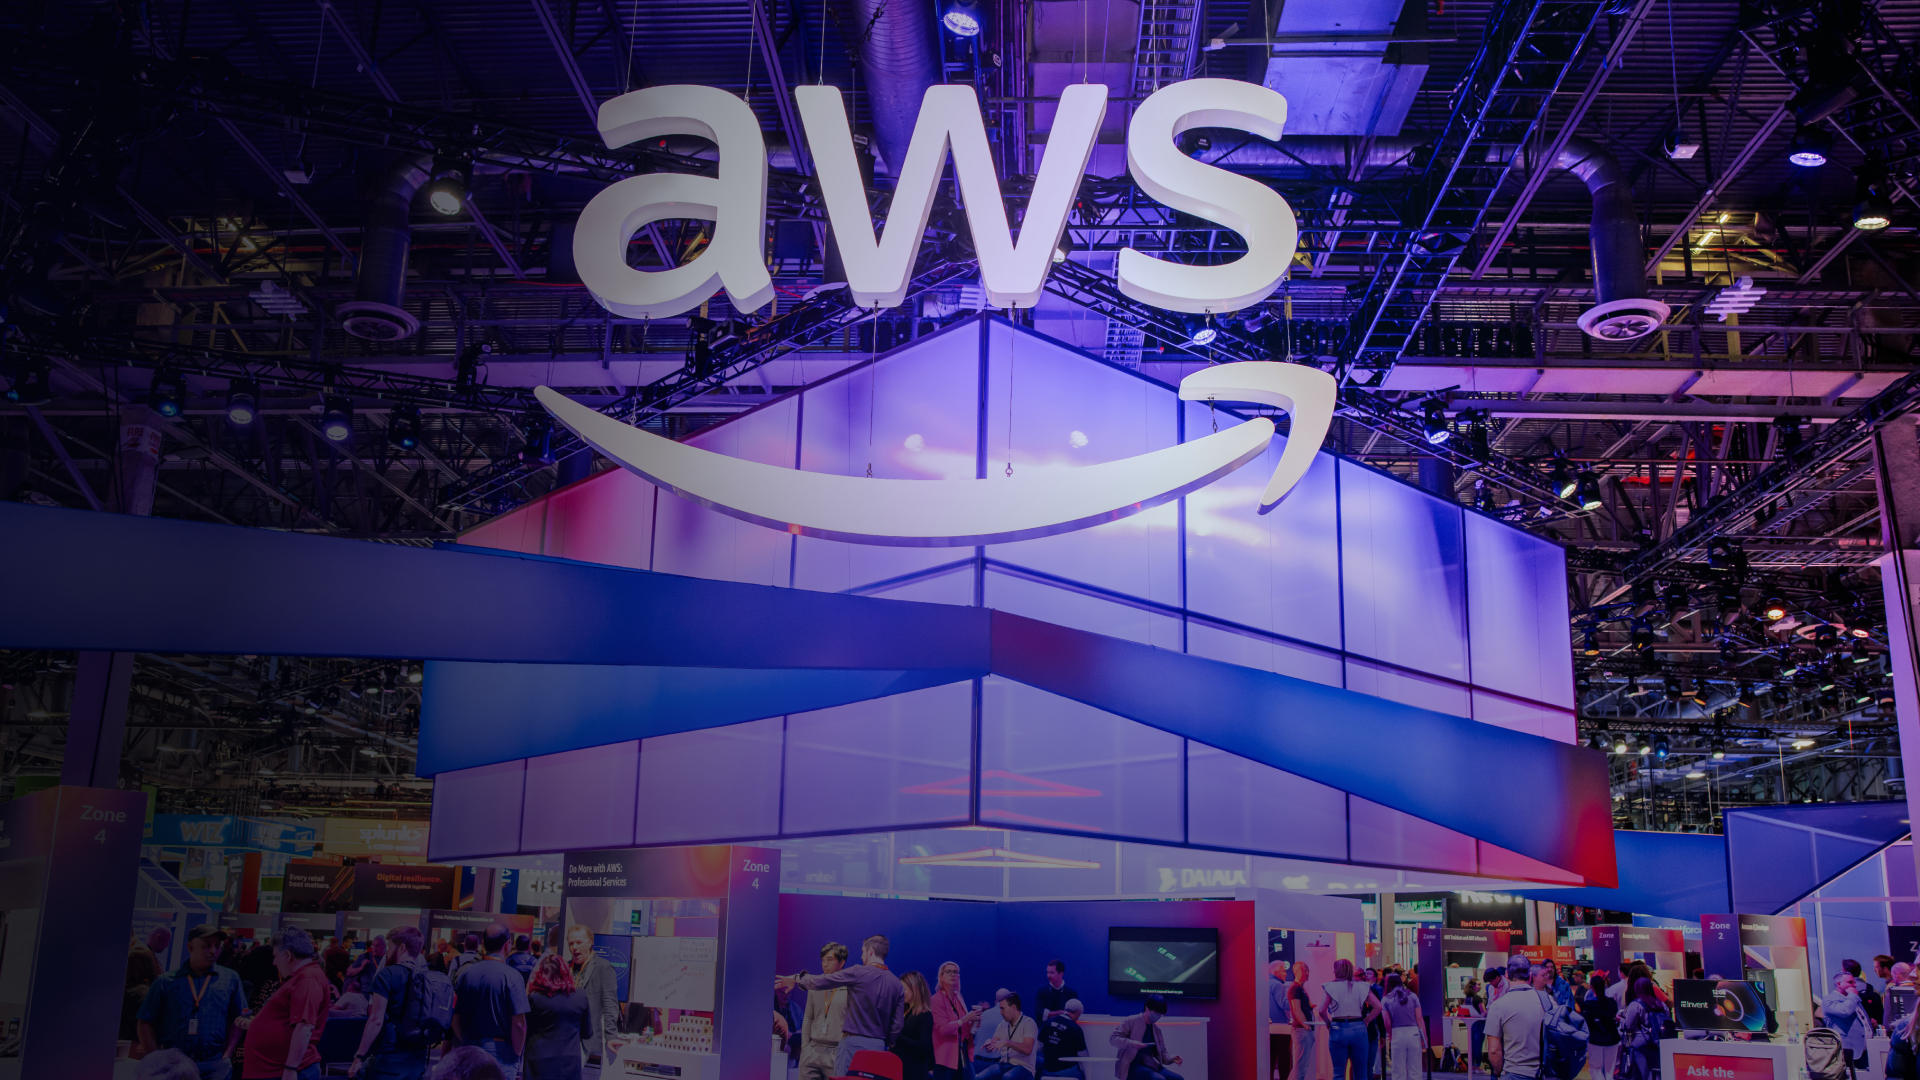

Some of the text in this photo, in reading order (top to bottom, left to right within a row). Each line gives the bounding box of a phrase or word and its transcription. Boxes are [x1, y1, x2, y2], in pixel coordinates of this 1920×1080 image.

[573, 79, 1298, 318] aws
[126, 428, 145, 436] FIRE
[80, 804, 126, 822] Zone
[94, 829, 106, 844] 4
[181, 822, 224, 843] WIZ
[569, 863, 623, 873] Do More with AWS:
[743, 860, 770, 873] Zone
[290, 874, 307, 882] Every
[377, 873, 401, 883] Digital
[568, 878, 626, 887] Professional Services
[752, 878, 759, 890] 4
[1687, 1065, 1734, 1078] Ask the
